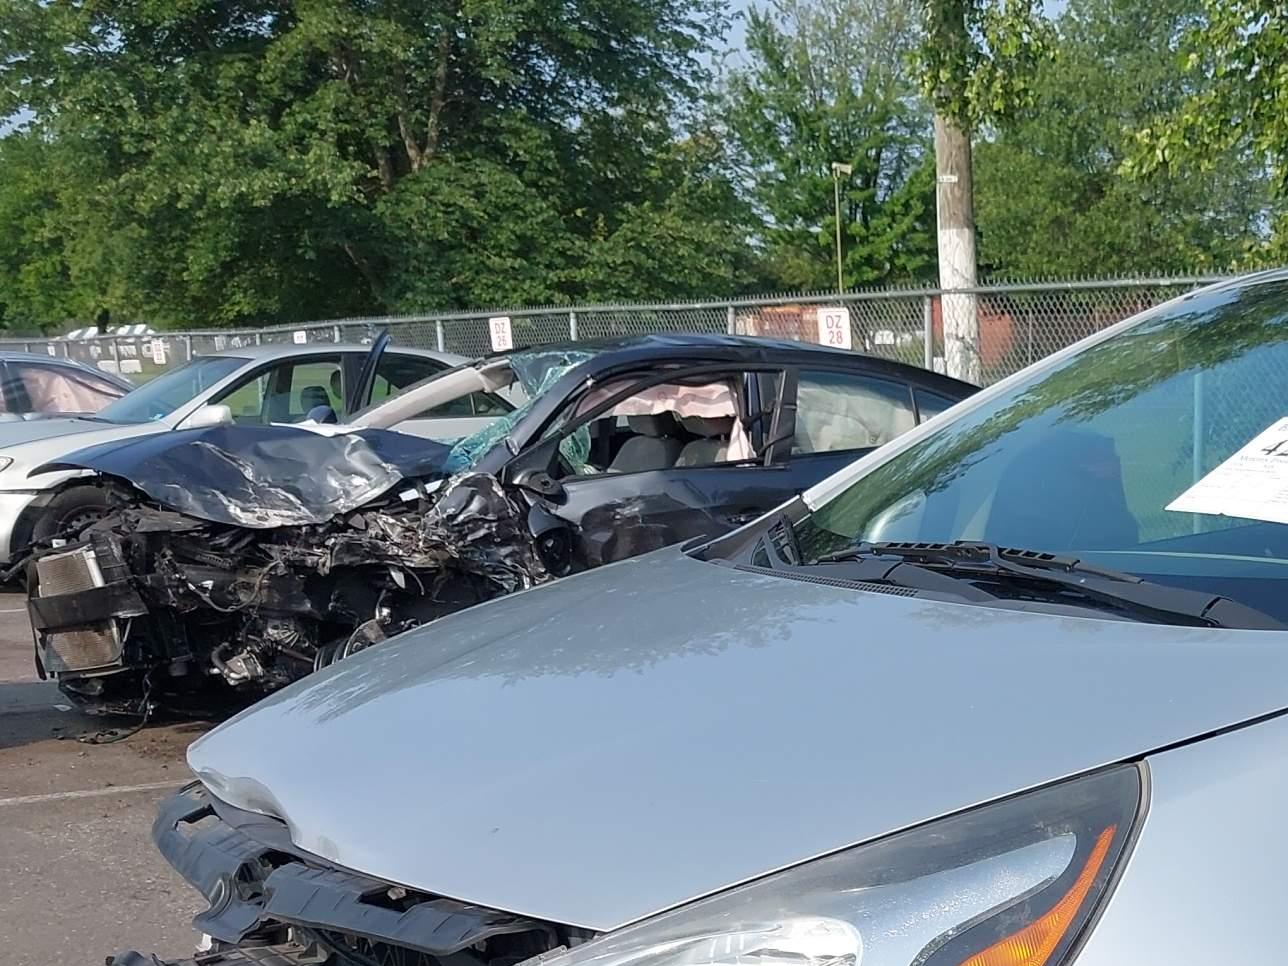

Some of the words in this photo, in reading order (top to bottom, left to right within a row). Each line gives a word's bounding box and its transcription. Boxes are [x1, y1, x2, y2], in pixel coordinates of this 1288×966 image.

[495, 322, 506, 334] DZ
[826, 315, 843, 329] DZ
[829, 331, 843, 344] 28
